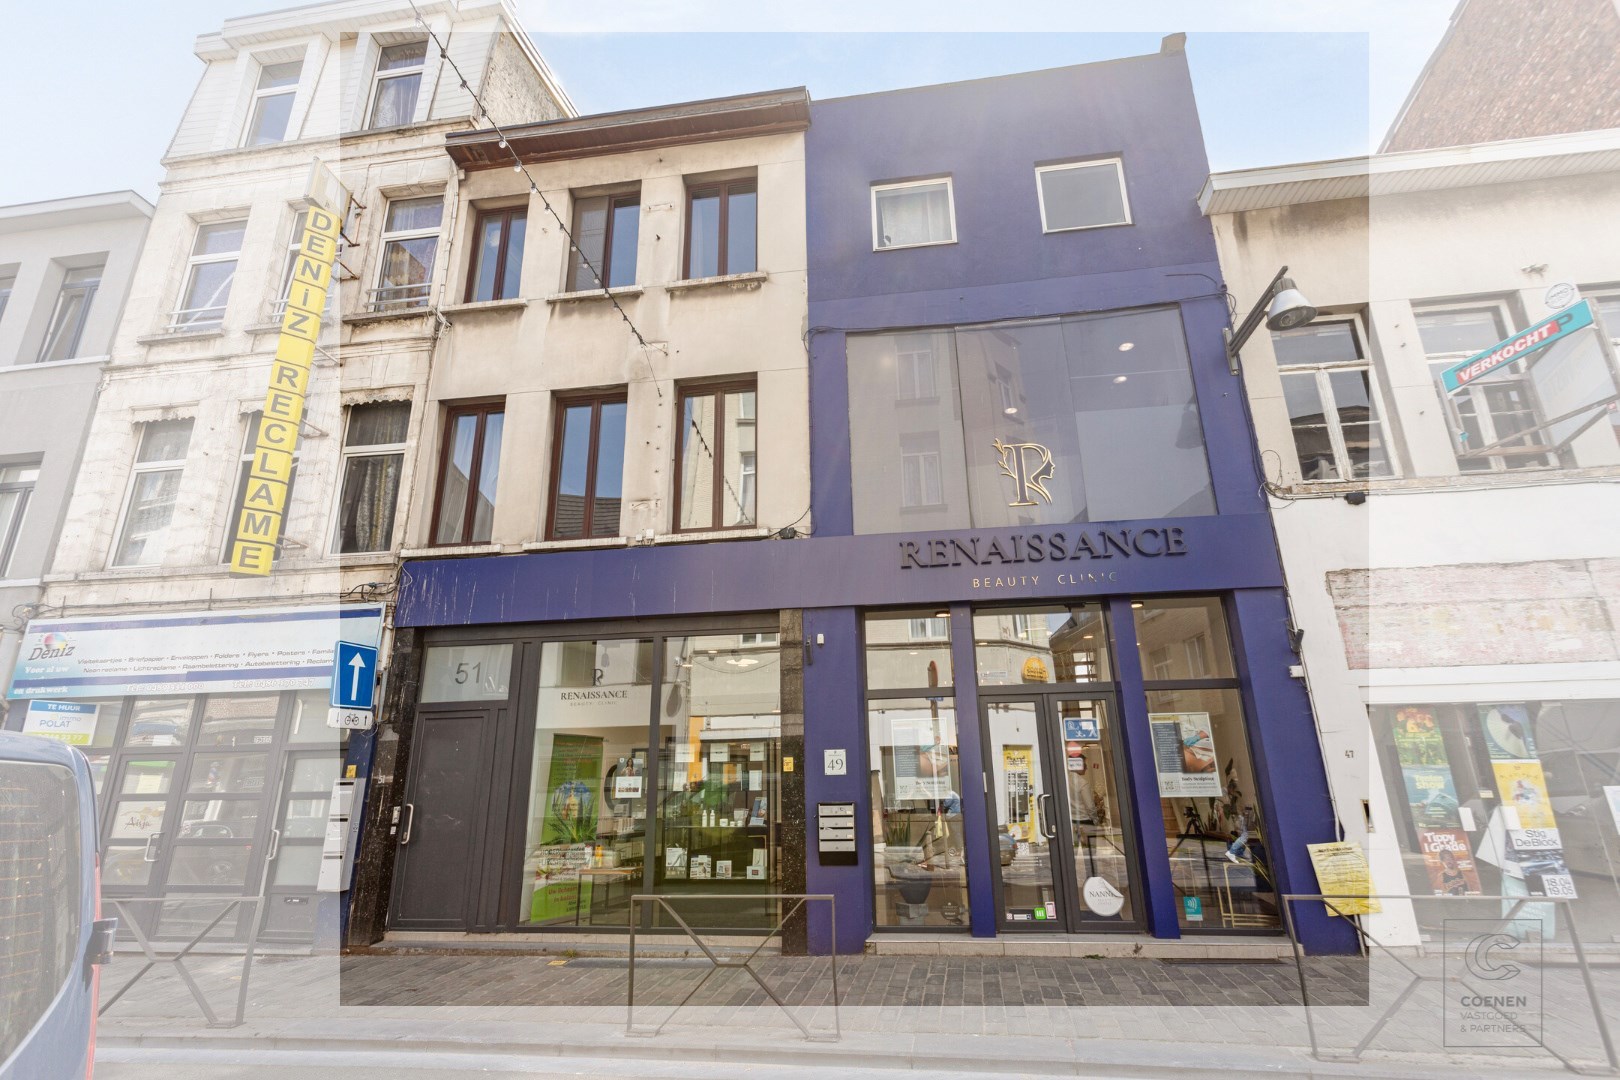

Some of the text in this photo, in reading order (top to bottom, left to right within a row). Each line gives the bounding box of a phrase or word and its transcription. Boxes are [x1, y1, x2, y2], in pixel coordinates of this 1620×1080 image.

[1458, 323, 1553, 383] VERKOCHT
[238, 363, 299, 570] RECLAME
[899, 526, 1188, 570] RENAISSANCE
[973, 571, 1118, 588] BEAUTY CLINIC
[28, 644, 76, 661] Deniz
[170, 653, 209, 662] Enveloppen
[247, 651, 269, 659] Flyers
[276, 649, 306, 657] Posters
[245, 659, 301, 668] Autobelettering
[454, 661, 482, 685] 51
[560, 690, 628, 700] RENAISSANCE
[39, 719, 71, 728] POLAT
[1344, 750, 1354, 758] 47
[827, 758, 844, 771] 49
[1423, 831, 1456, 847] Tippy
[1525, 829, 1547, 839] Stig
[1430, 840, 1467, 852] Grade
[1515, 837, 1558, 847] De Block
